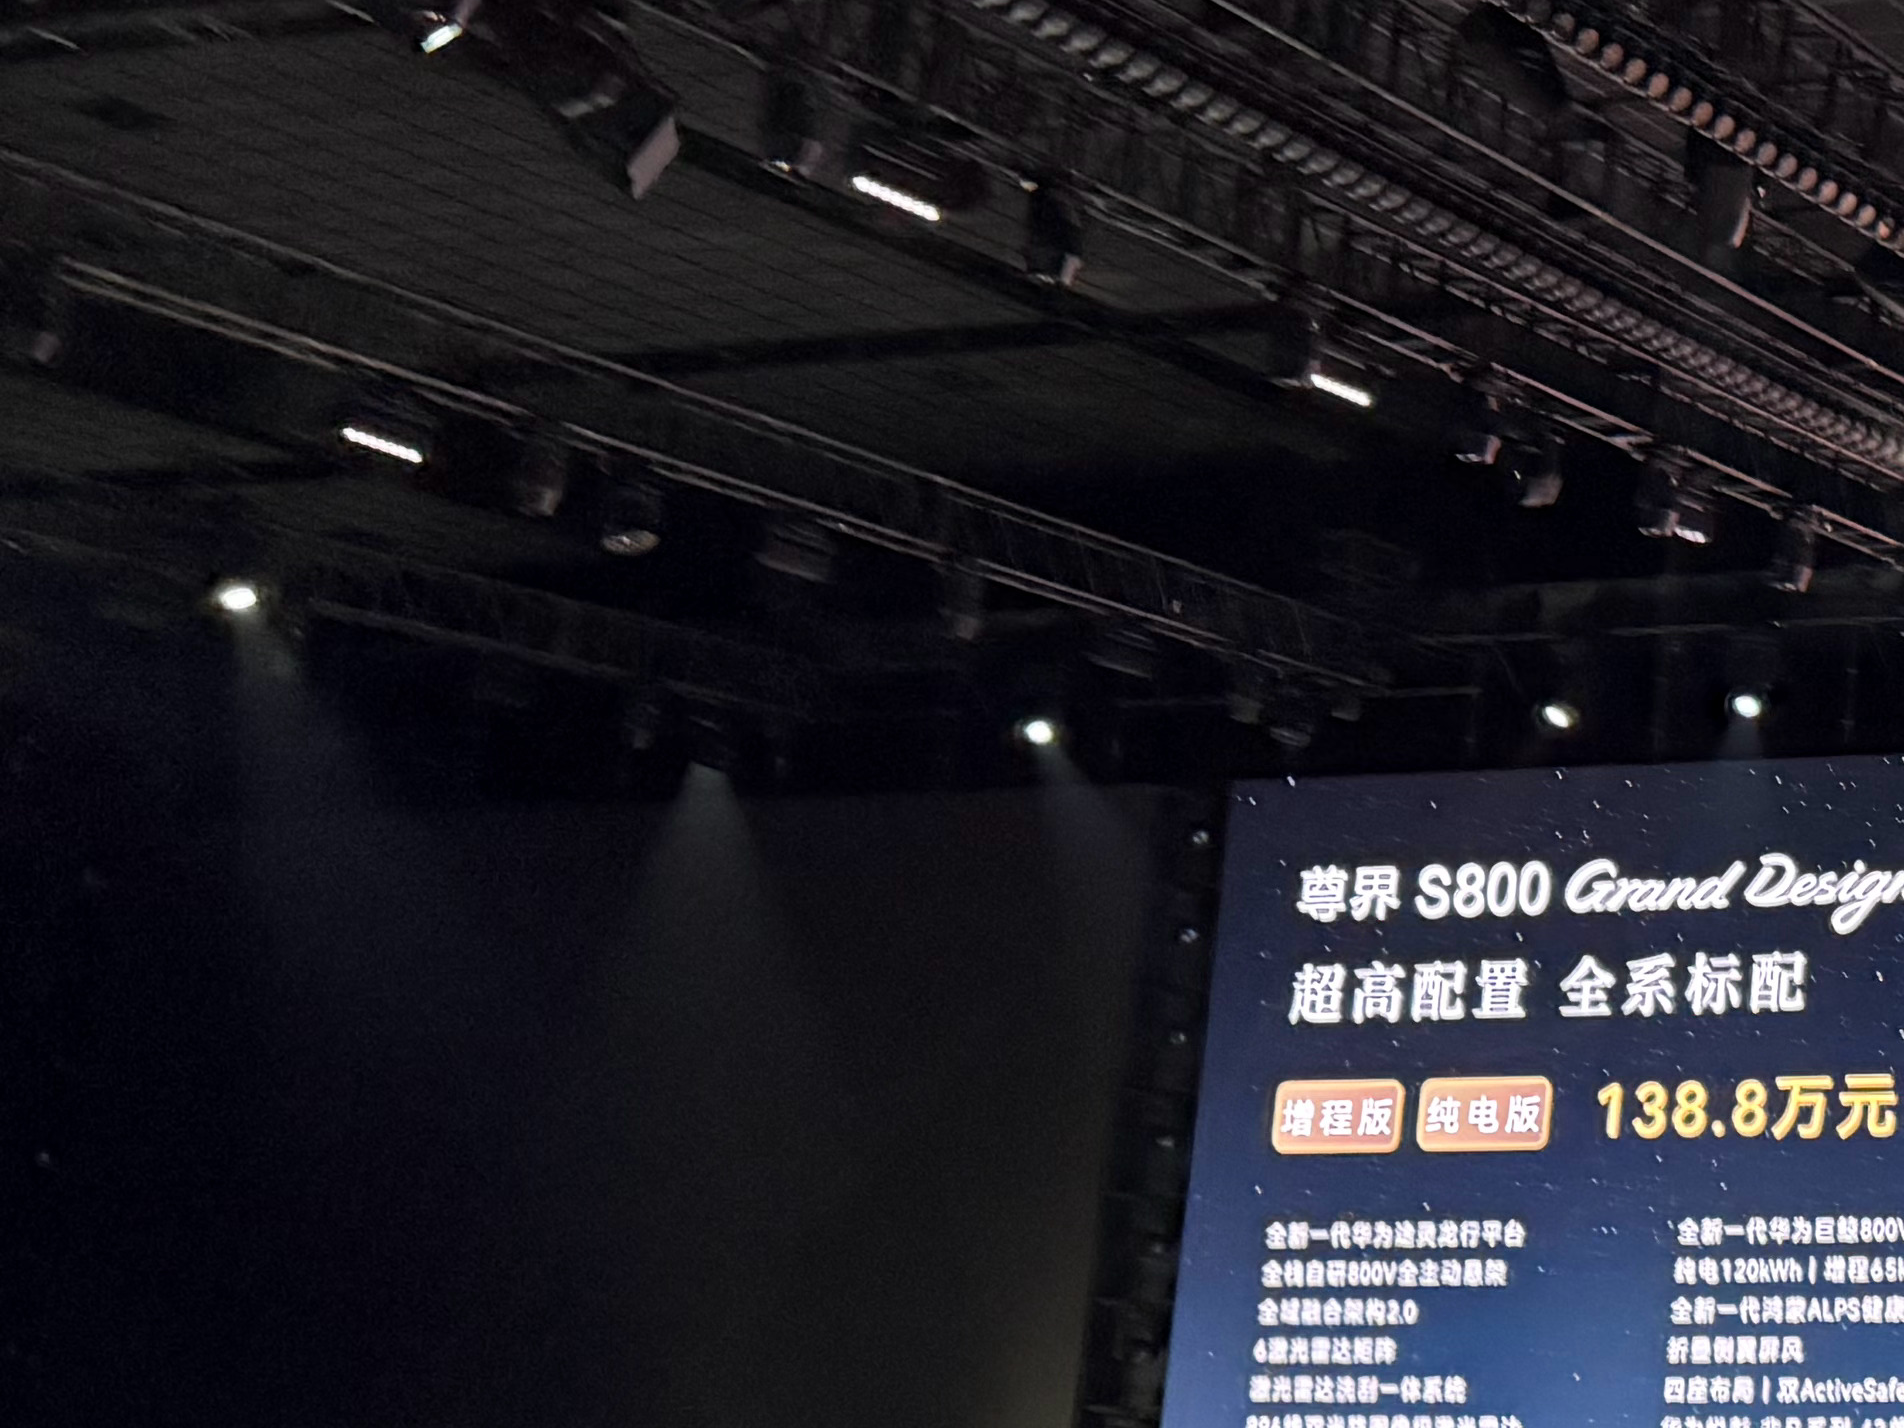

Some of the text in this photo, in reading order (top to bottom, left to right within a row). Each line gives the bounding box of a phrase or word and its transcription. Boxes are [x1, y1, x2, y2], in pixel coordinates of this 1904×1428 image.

[1297, 865, 1400, 922] 尊界
[1415, 861, 1551, 919] S800
[1565, 858, 1748, 914] Grand
[1289, 951, 1807, 1024] 超高配置 全系标配
[1280, 1074, 1898, 1140] 增程版 纯电版 138.8万元
[1673, 1256, 1804, 1286] 纯电120kWh
[1664, 1376, 1755, 1405] 四座布局
